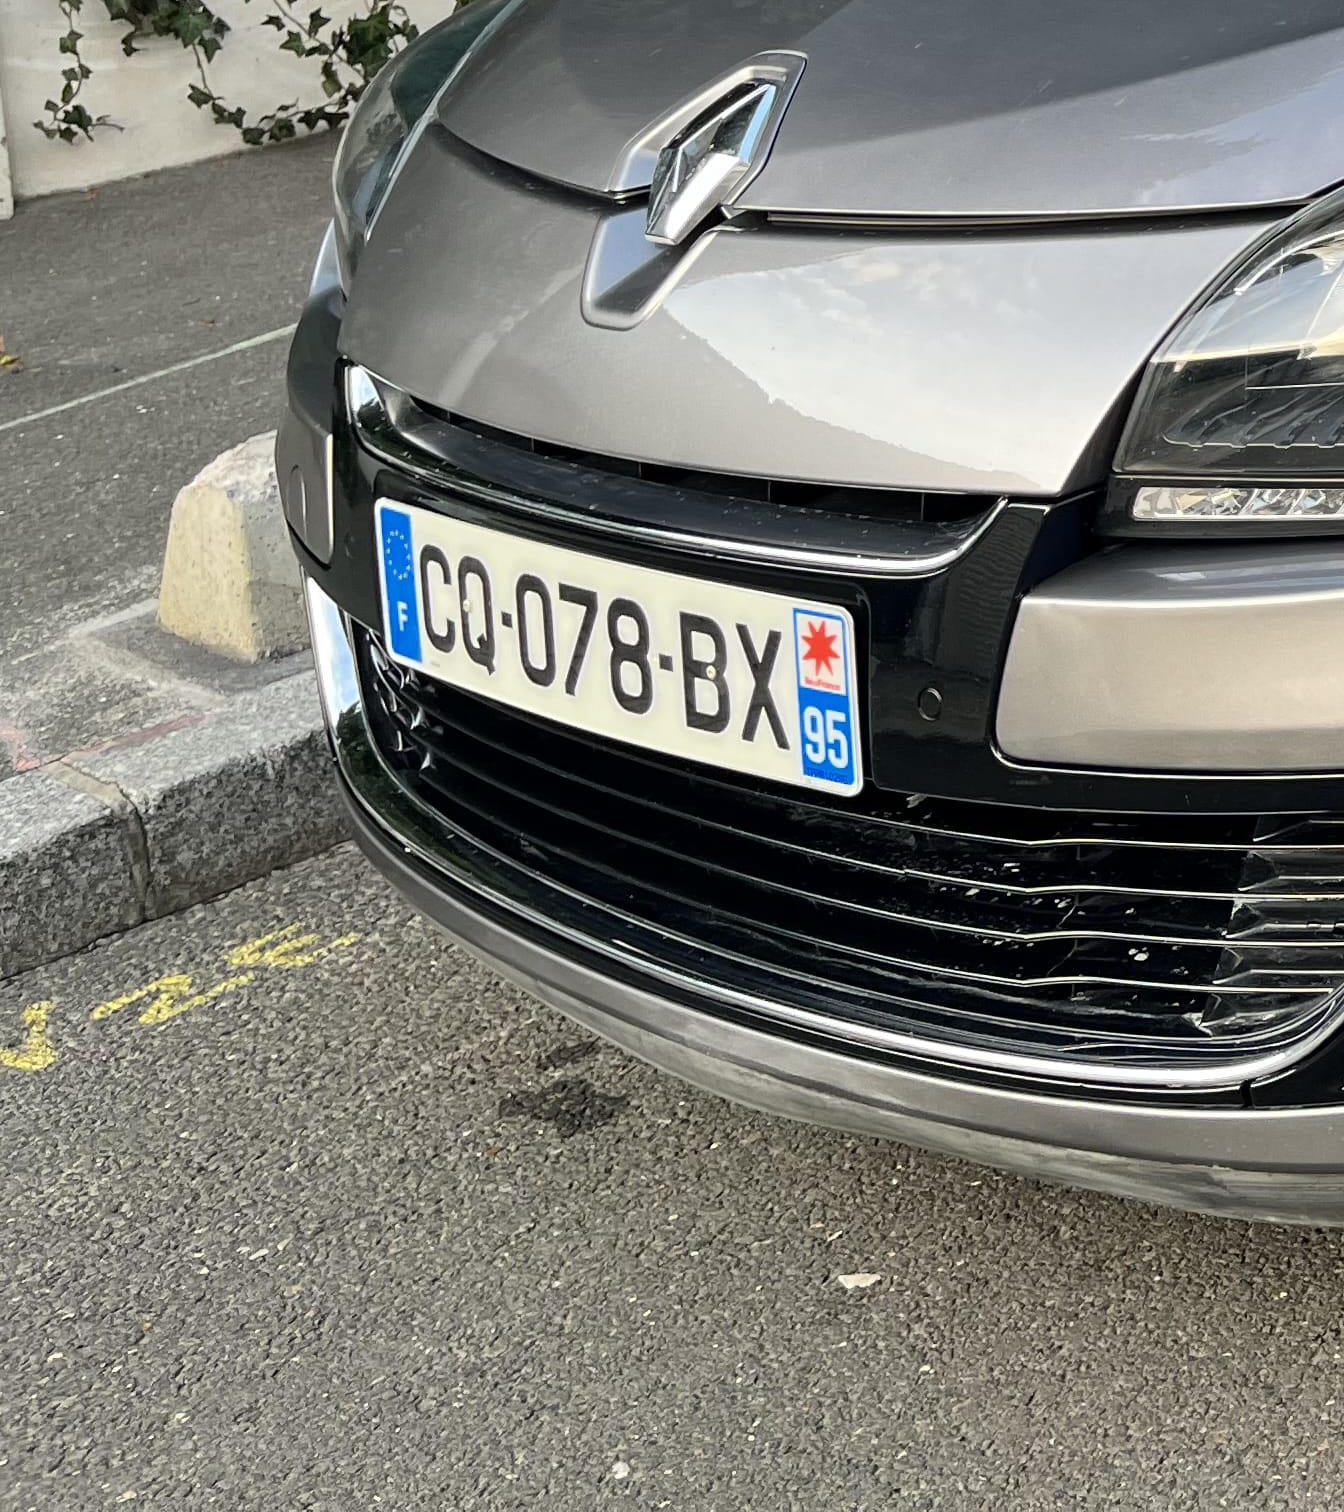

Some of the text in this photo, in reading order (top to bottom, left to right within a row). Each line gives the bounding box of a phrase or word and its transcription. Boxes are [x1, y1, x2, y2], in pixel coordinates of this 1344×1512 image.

[396, 600, 409, 632] F
[419, 544, 790, 751] CQ-078-BX
[803, 705, 849, 769] 95
